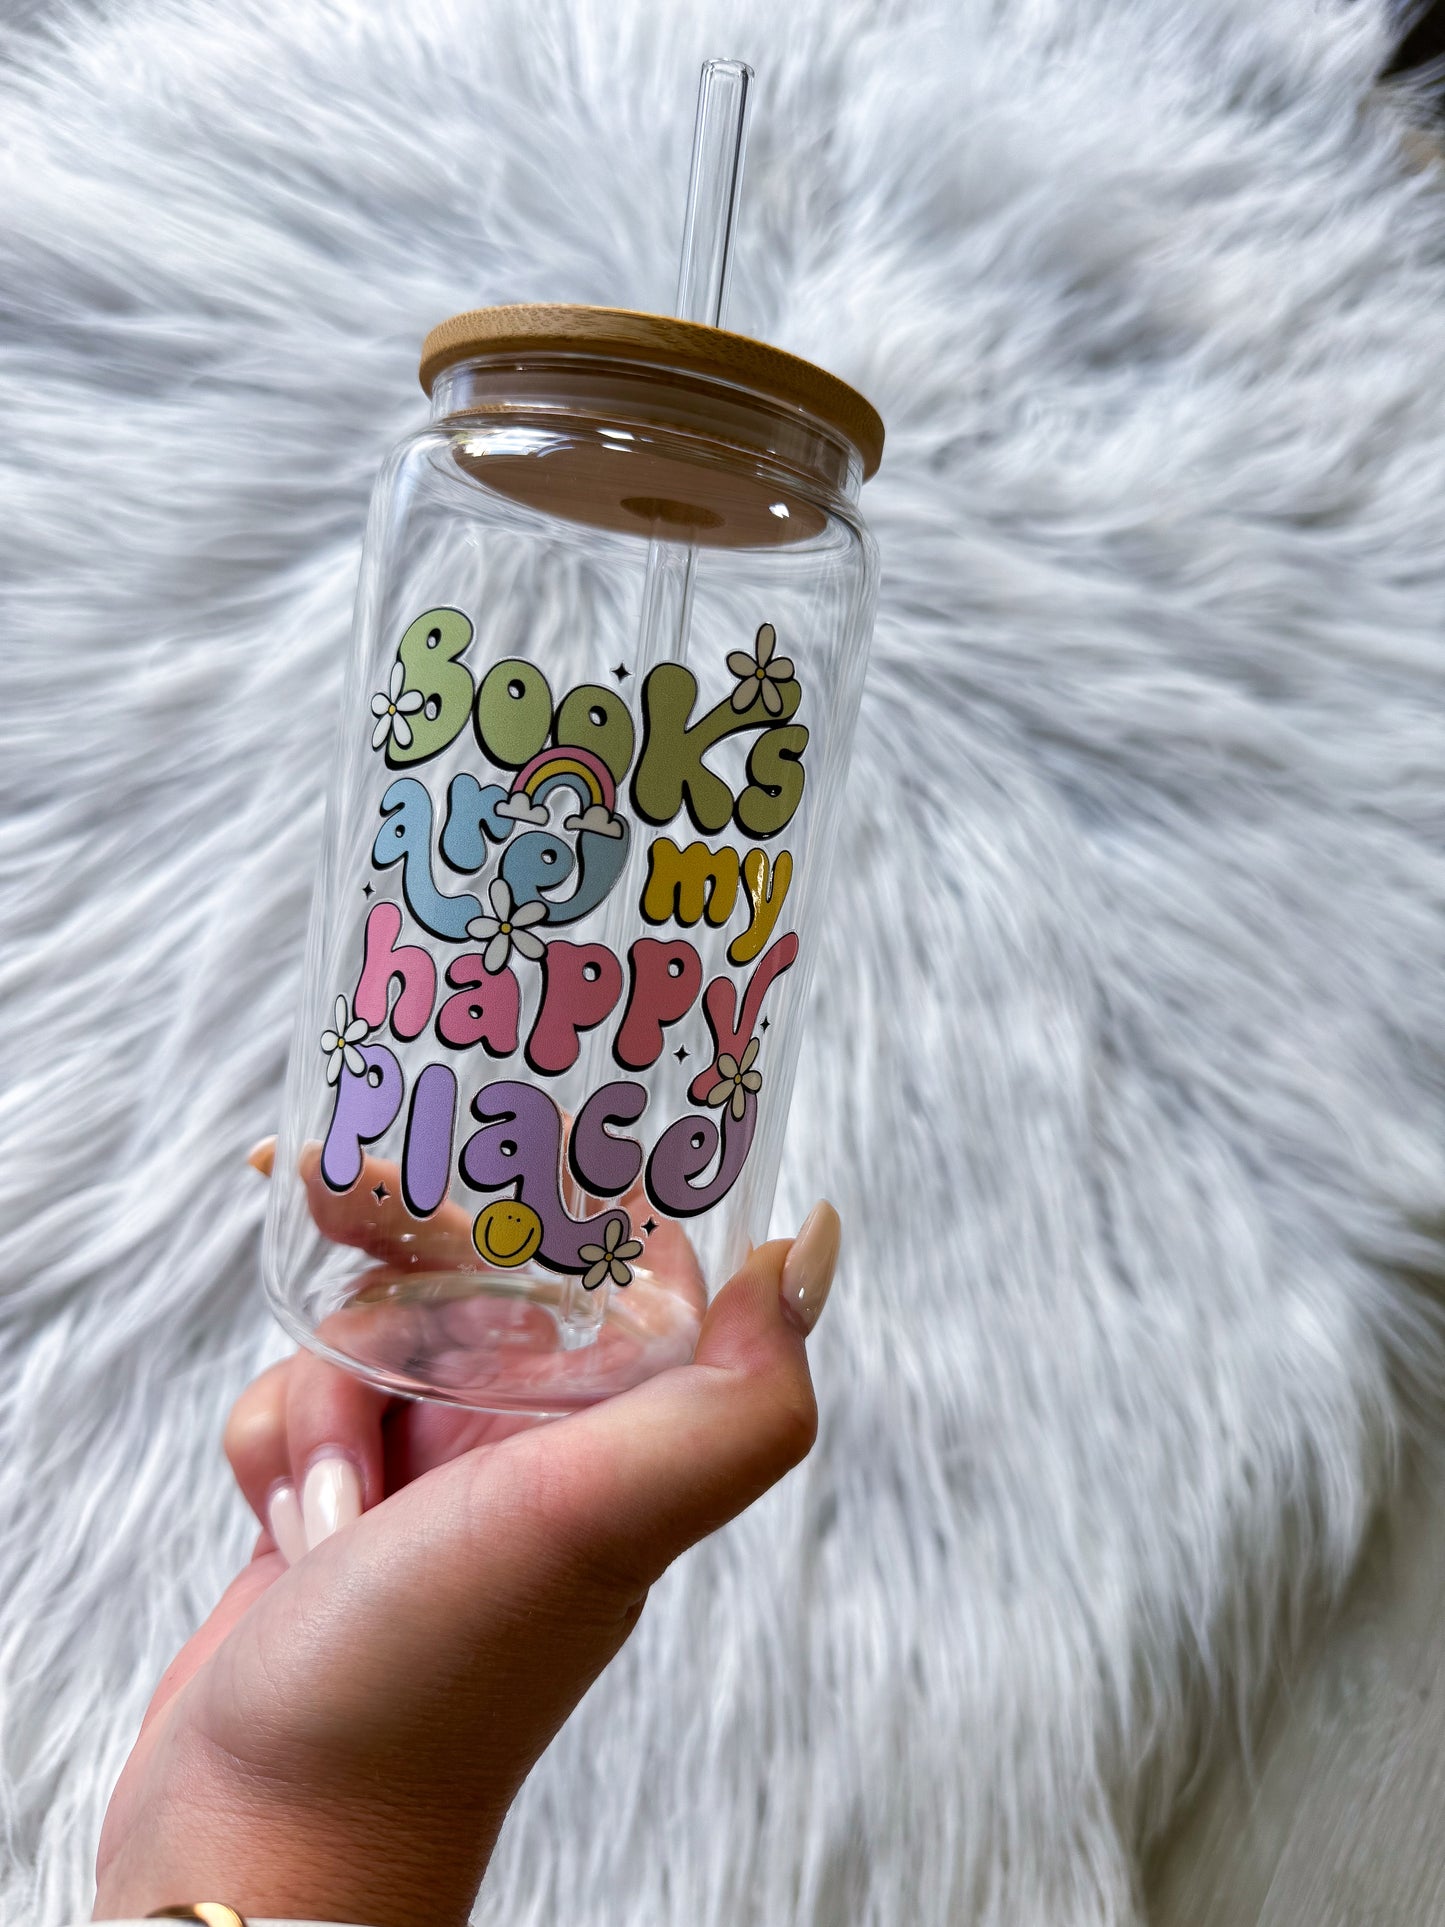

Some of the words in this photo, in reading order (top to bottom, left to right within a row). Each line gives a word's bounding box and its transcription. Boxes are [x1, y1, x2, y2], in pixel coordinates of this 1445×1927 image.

[371, 773, 630, 942] are
[640, 836, 794, 967] my
[351, 901, 800, 1106] happy
